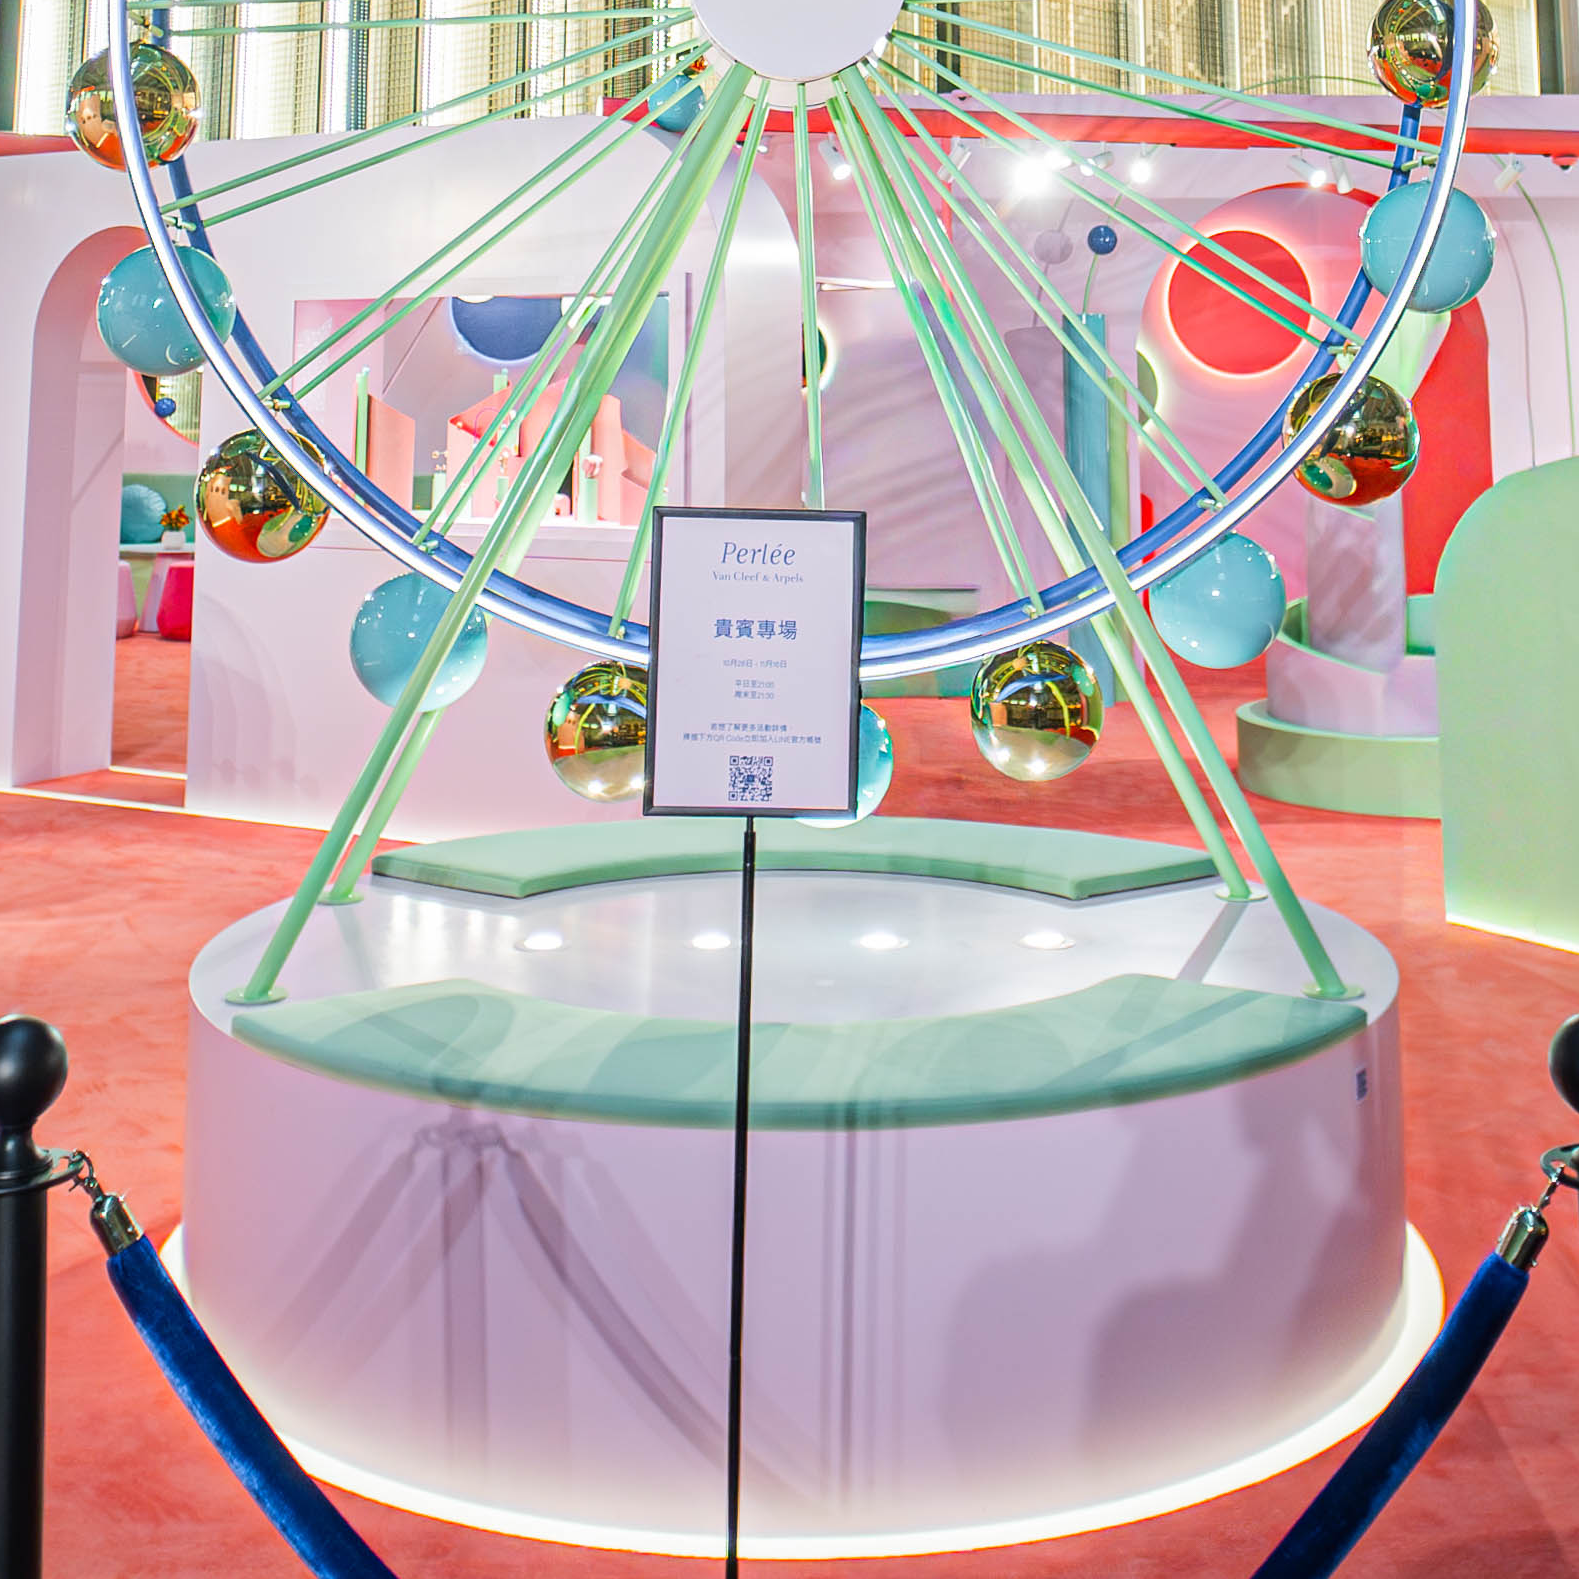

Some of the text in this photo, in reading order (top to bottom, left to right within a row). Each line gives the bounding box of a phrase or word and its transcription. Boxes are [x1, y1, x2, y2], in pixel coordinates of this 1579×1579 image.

[720, 541, 796, 566] Perlée
[712, 570, 731, 581] Van
[733, 570, 760, 582] Cleef
[773, 572, 804, 585] Arpels
[713, 618, 798, 640] 貴賓專場
